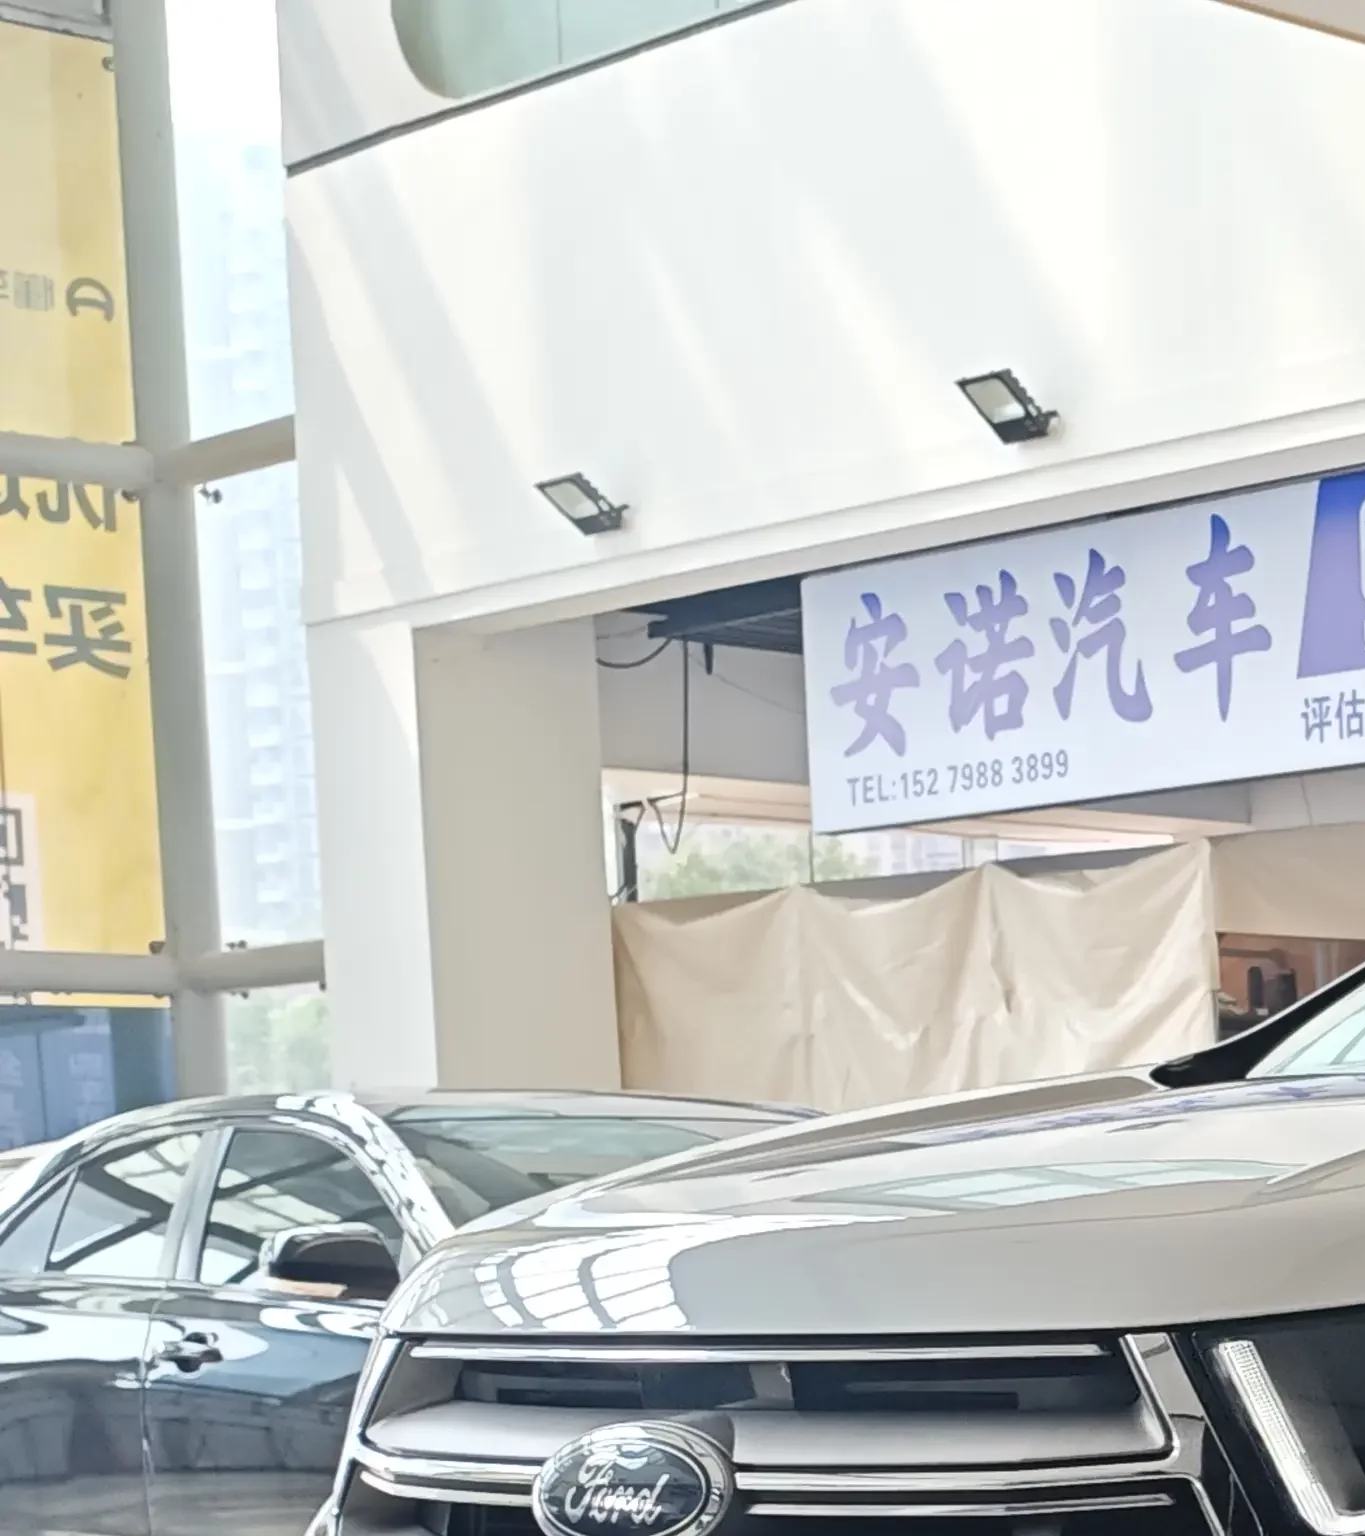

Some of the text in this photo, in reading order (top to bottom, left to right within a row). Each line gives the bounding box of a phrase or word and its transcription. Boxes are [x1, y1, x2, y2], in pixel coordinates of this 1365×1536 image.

[829, 512, 1273, 758] 安诺汽车
[946, 759, 1004, 793] 7988
[1011, 749, 1069, 784] 3899
[564, 1450, 671, 1525] Ford
